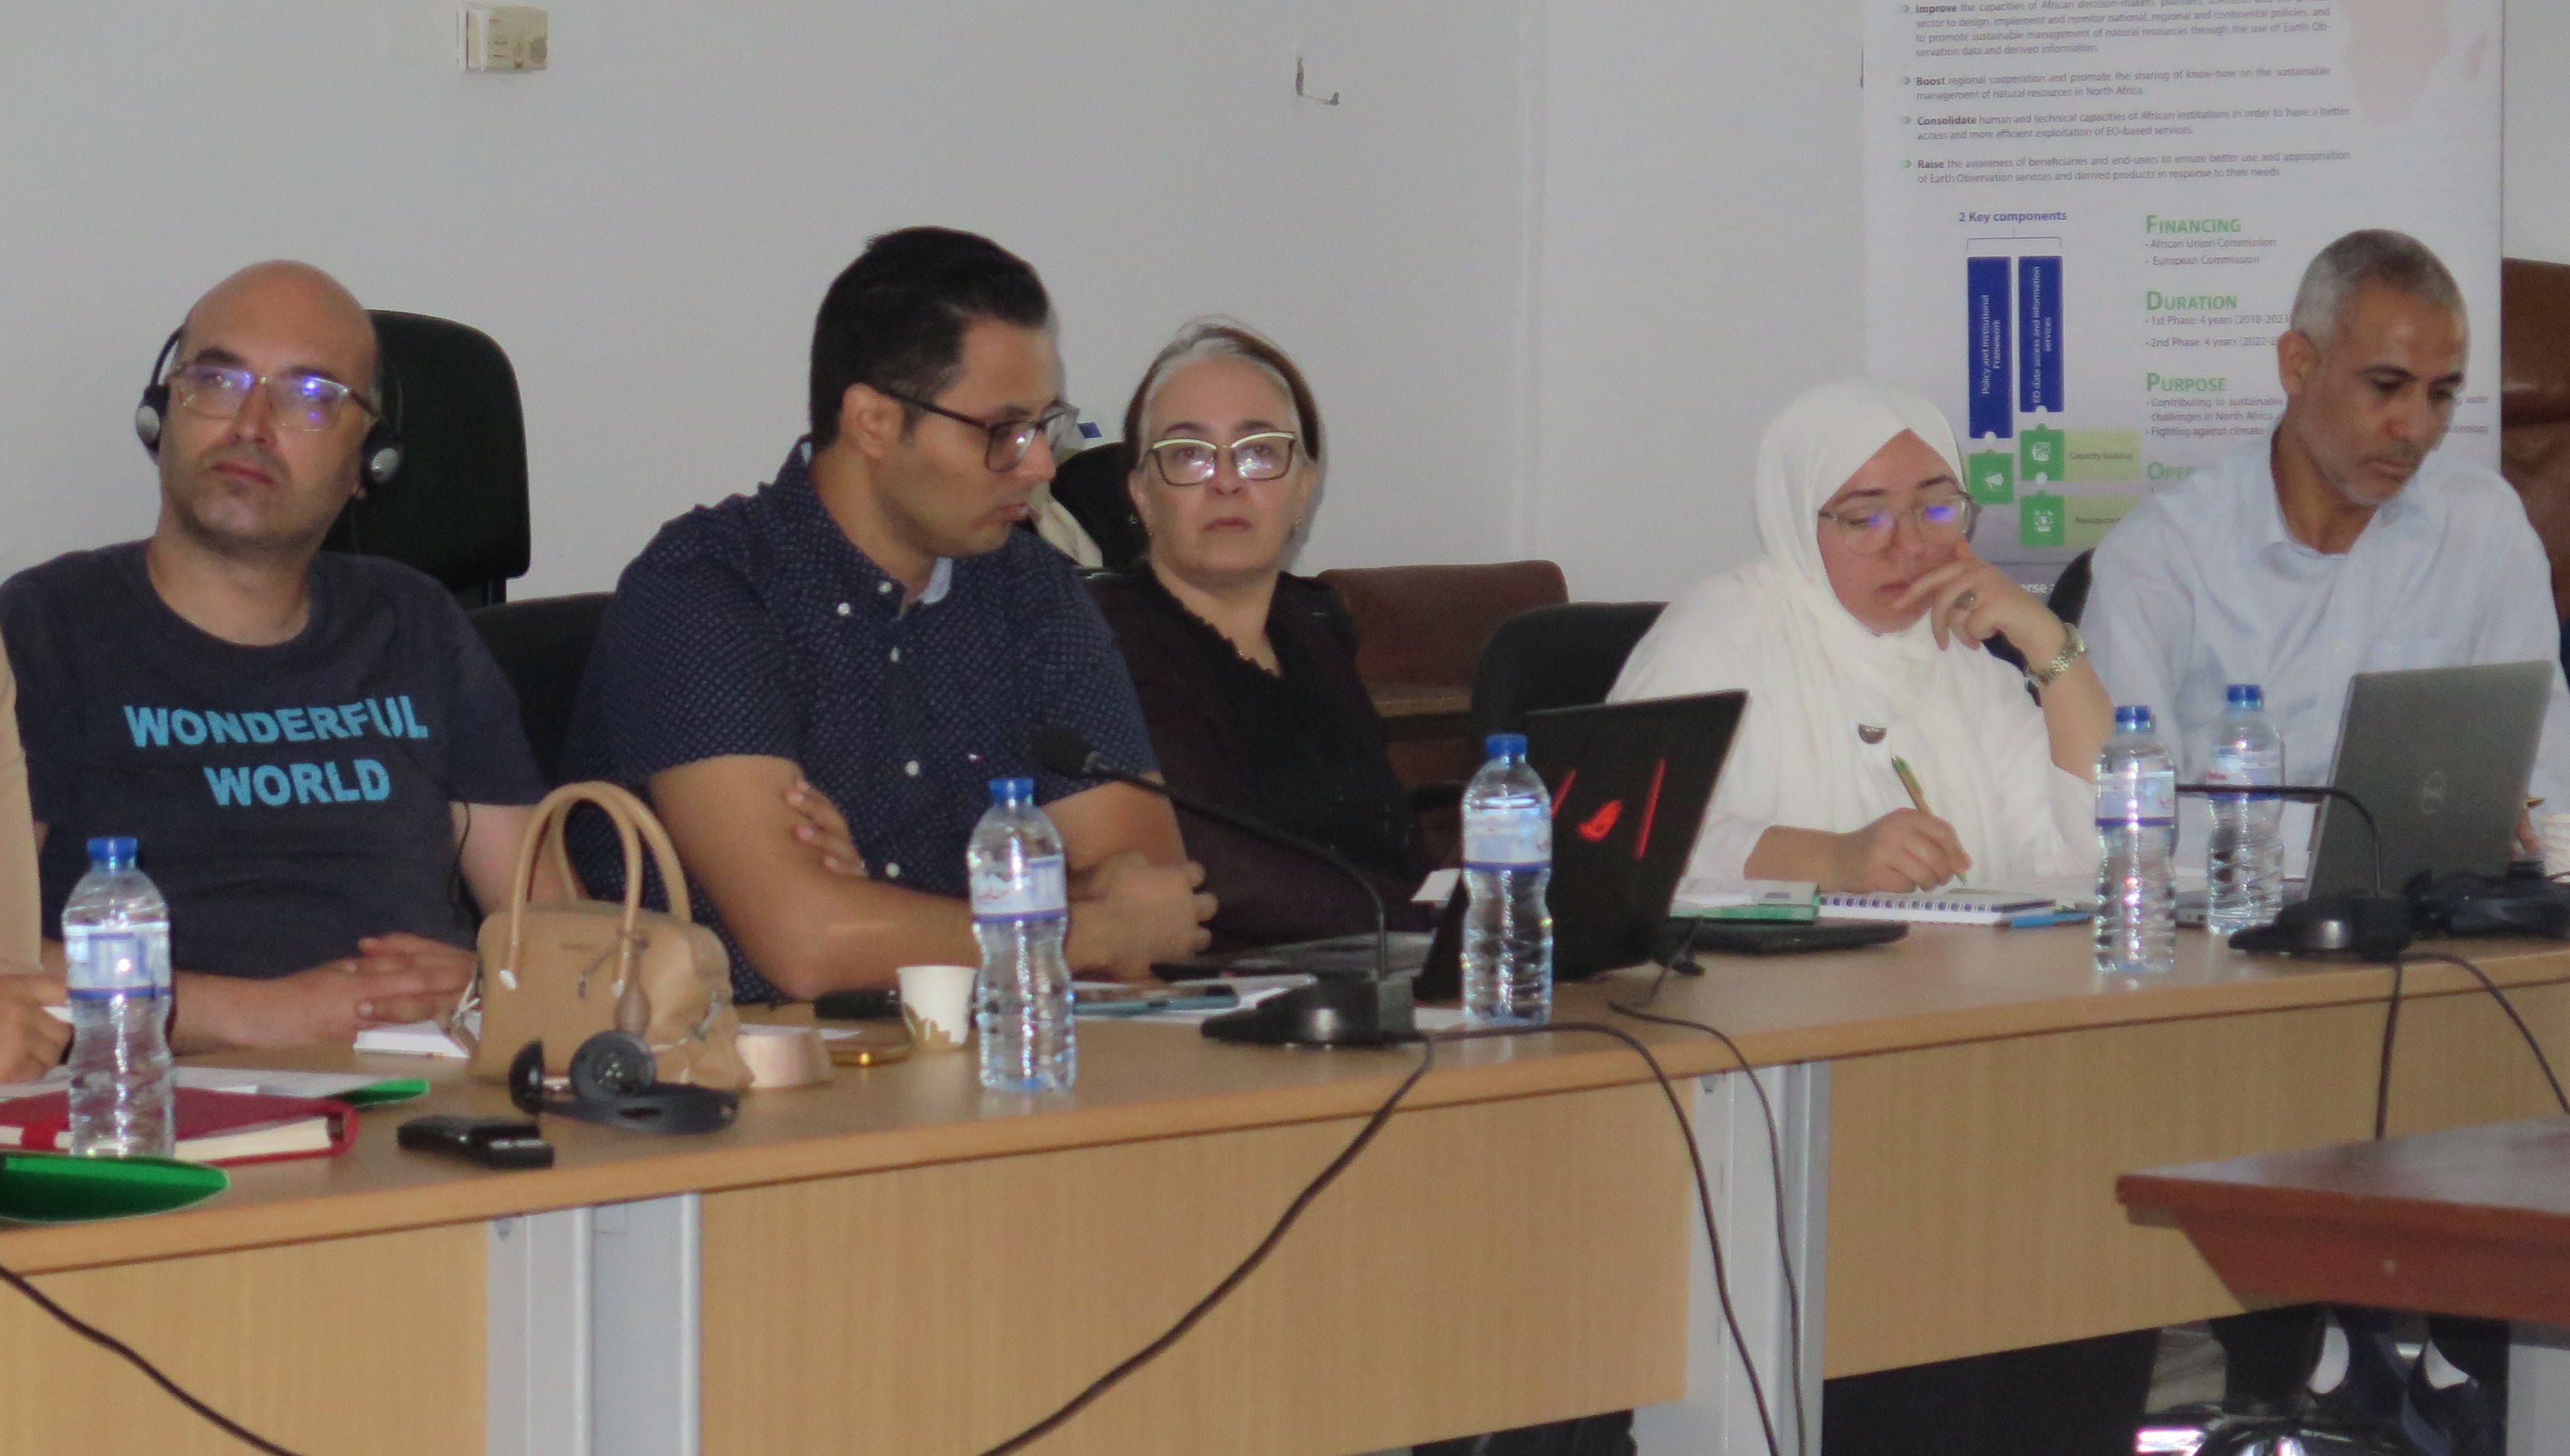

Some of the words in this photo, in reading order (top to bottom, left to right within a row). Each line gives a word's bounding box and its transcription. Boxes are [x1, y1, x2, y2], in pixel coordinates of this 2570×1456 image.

[1916, 4, 1957, 14] Improve
[1961, 3, 1975, 12] the
[1979, 2, 2023, 13] capacities
[2028, 1, 2037, 10] of
[2041, 0, 2072, 10] African
[1916, 19, 1944, 27] sector
[1946, 19, 1956, 27] to
[1994, 16, 2045, 27] implement
[2048, 16, 2065, 25] and
[2068, 15, 2105, 24] monitor
[2152, 11, 2191, 23] regional
[2194, 10, 2211, 19] and
[2214, 9, 2268, 19] continental
[2312, 7, 2331, 16] and
[1916, 33, 1926, 42] to
[1929, 33, 1967, 45] promote
[1972, 30, 2023, 41] sustainable
[2027, 29, 2090, 41] management
[2094, 27, 2103, 37] of
[2105, 27, 2139, 36] natural
[2142, 27, 2188, 36] resources
[2192, 24, 2228, 36] through
[2232, 24, 2248, 33] the
[2251, 25, 2266, 33] use
[2270, 23, 2280, 32] of
[2283, 22, 2309, 32] Earth
[2312, 21, 2331, 31] Ob-
[1916, 48, 1958, 57] servation
[1962, 45, 1983, 56] data
[1985, 45, 2001, 55] and
[2004, 45, 2039, 54] derived
[1917, 77, 1946, 86] Boost
[1949, 76, 1986, 88] regional
[1990, 74, 2045, 86] cooperation
[2049, 74, 2066, 82] and
[2070, 73, 2111, 84] promote
[2115, 71, 2130, 81] the
[2134, 71, 2169, 82] sharing
[2173, 69, 2182, 79] of
[2187, 69, 2236, 79] know-how
[2240, 70, 2253, 78] on
[2257, 68, 2271, 77] the
[2276, 66, 2331, 77] sustainable
[1917, 91, 1979, 101] management
[1982, 90, 1990, 99] of
[1993, 88, 2025, 99] natural
[2027, 89, 2072, 97] resources
[2074, 88, 2084, 96] in
[2086, 87, 2114, 97] North
[1917, 116, 1976, 126] Consolidate
[1979, 115, 2011, 125] human
[2014, 114, 2031, 123] and
[2034, 114, 2077, 123] technical
[2079, 112, 2126, 123] capacities
[2129, 111, 2137, 120] of
[2141, 110, 2175, 121] African
[2178, 109, 2230, 120] institutions
[2232, 109, 2242, 119] in
[2244, 109, 2270, 118] order
[2273, 109, 2282, 117] to
[2285, 107, 2309, 117] have
[2312, 109, 2318, 117] a
[2320, 106, 2350, 116] better
[1917, 132, 1949, 140] access
[1950, 130, 1967, 140] and
[1970, 131, 1993, 139] more
[1996, 129, 2033, 139] efficient
[2036, 128, 2092, 139] exploitation
[2094, 127, 2103, 136] of
[2107, 126, 2152, 136] EO-based
[1917, 160, 1944, 169] Raise
[1947, 158, 1962, 169] the
[1965, 159, 2013, 168] awareness
[2016, 158, 2025, 167] of
[2029, 156, 2088, 167] beneficiaries
[2091, 155, 2108, 165] and
[2111, 155, 2159, 165] end-users
[2162, 155, 2172, 164] to
[2175, 155, 2207, 164] ensure
[2210, 153, 2238, 163] better
[2242, 153, 2258, 162] use
[2261, 152, 2280, 161] and
[2283, 151, 2351, 163] appropriation
[1917, 174, 1927, 184] of
[1930, 173, 1955, 183] Earth
[1957, 172, 2013, 183] Observation
[2016, 172, 2051, 182] services
[2055, 172, 2072, 181] and
[2075, 171, 2110, 181] derived
[2113, 169, 2155, 181] products
[2158, 169, 2166, 178] in
[2169, 169, 2212, 180] response
[2214, 168, 2224, 178] to
[2227, 166, 2247, 177] their
[1958, 213, 1966, 222] 2
[1969, 212, 1990, 224] Key
[1993, 211, 2068, 224] components
[2146, 214, 2242, 233] FINANCING
[2151, 239, 2184, 248] African
[2187, 239, 2215, 247] Union
[2218, 237, 2276, 247] Commission
[2152, 256, 2196, 266] European
[2201, 255, 2259, 265] Commission
[2033, 266, 2041, 317] information
[2146, 291, 2238, 311] DURATION
[2152, 316, 2165, 325] 1st
[2200, 316, 2206, 324] 4
[2208, 316, 2233, 326] years
[2235, 314, 2292, 324] (2018-2021
[2151, 338, 2169, 347] 2nd
[2204, 337, 2210, 346] 4
[2214, 337, 2237, 347] years
[2240, 336, 2277, 346] (2022-2
[1981, 368, 1991, 394] Policy
[2146, 372, 2227, 392] PURPOSE
[2033, 391, 2041, 403] EO
[2152, 398, 2212, 409] Contributing
[2215, 398, 2225, 407] to
[2229, 396, 2284, 407] sustainable
[2152, 412, 2201, 422] challenges
[2204, 411, 2213, 421] in
[2215, 411, 2243, 420] North
[2247, 410, 2273, 420] Africa
[2152, 427, 2191, 438] Fighting
[2192, 427, 2228, 438] against
[2230, 426, 2264, 436] climate
[123, 695, 430, 748] WONDERFUL
[203, 758, 392, 806] WORLD
